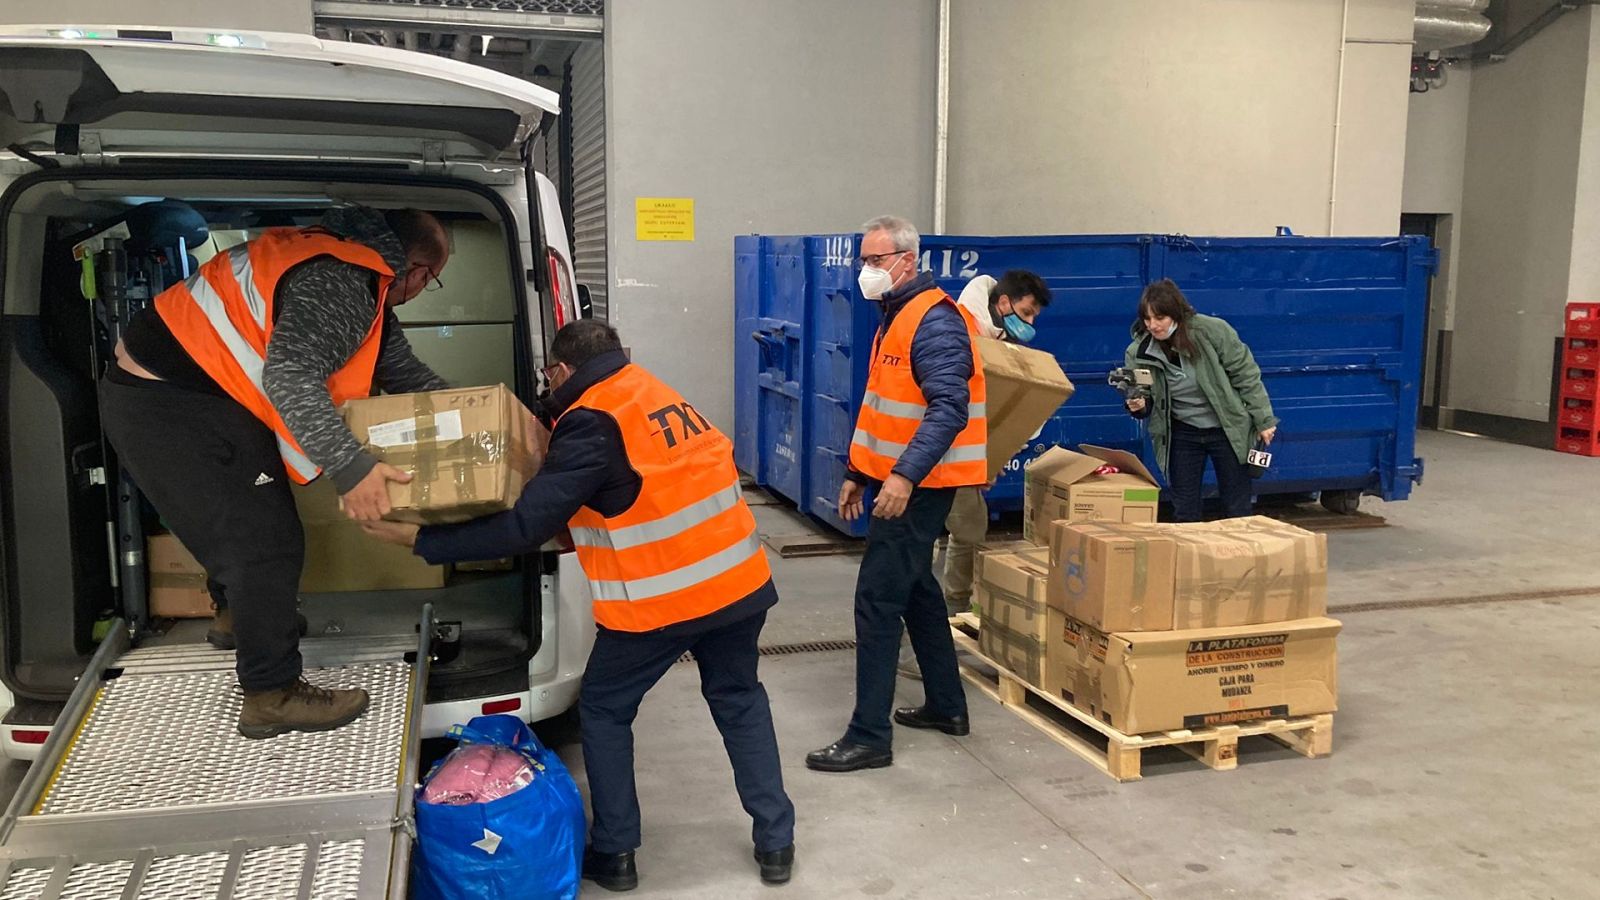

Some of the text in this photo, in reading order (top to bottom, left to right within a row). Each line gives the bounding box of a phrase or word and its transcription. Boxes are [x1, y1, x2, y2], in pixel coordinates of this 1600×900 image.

[882, 354, 901, 367] TXT
[647, 401, 711, 449] TXT
[1188, 635, 1286, 652] LA PLATAFORMA
[1188, 655, 1200, 664] DE
[1202, 653, 1212, 663] LA
[1187, 666, 1218, 676] AHORRE
[1221, 664, 1249, 673] TIEMPO
[1257, 659, 1285, 668] DINERO
[1219, 673, 1255, 687] CAJA PARA
[1222, 686, 1252, 698] MUDANZA
